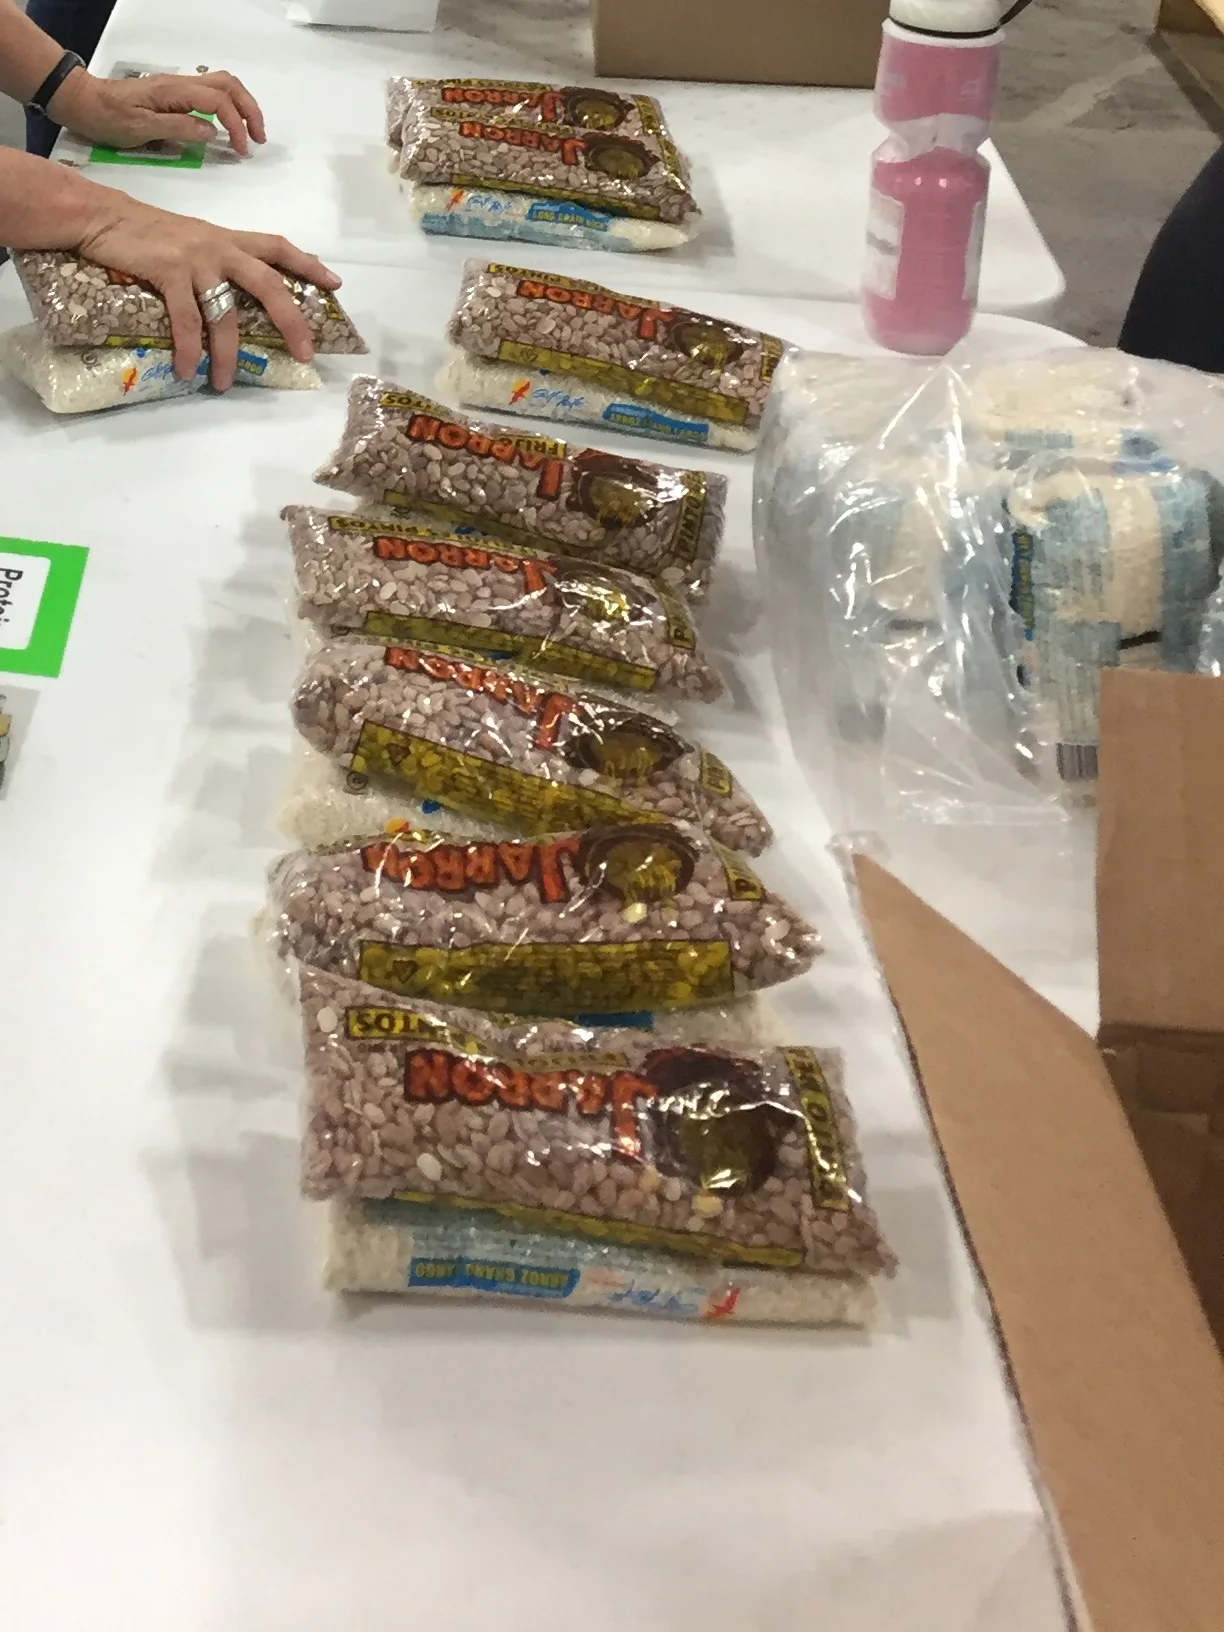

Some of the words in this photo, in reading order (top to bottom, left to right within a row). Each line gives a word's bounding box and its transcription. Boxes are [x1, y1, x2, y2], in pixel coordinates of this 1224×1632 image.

[458, 121, 587, 167] JARRON
[516, 280, 676, 342] JARRON
[404, 414, 566, 502] JARRON
[372, 536, 558, 596] JARRON
[383, 647, 584, 751] JARRON
[361, 837, 582, 903] JARRON
[403, 1048, 659, 1165] JARRON
